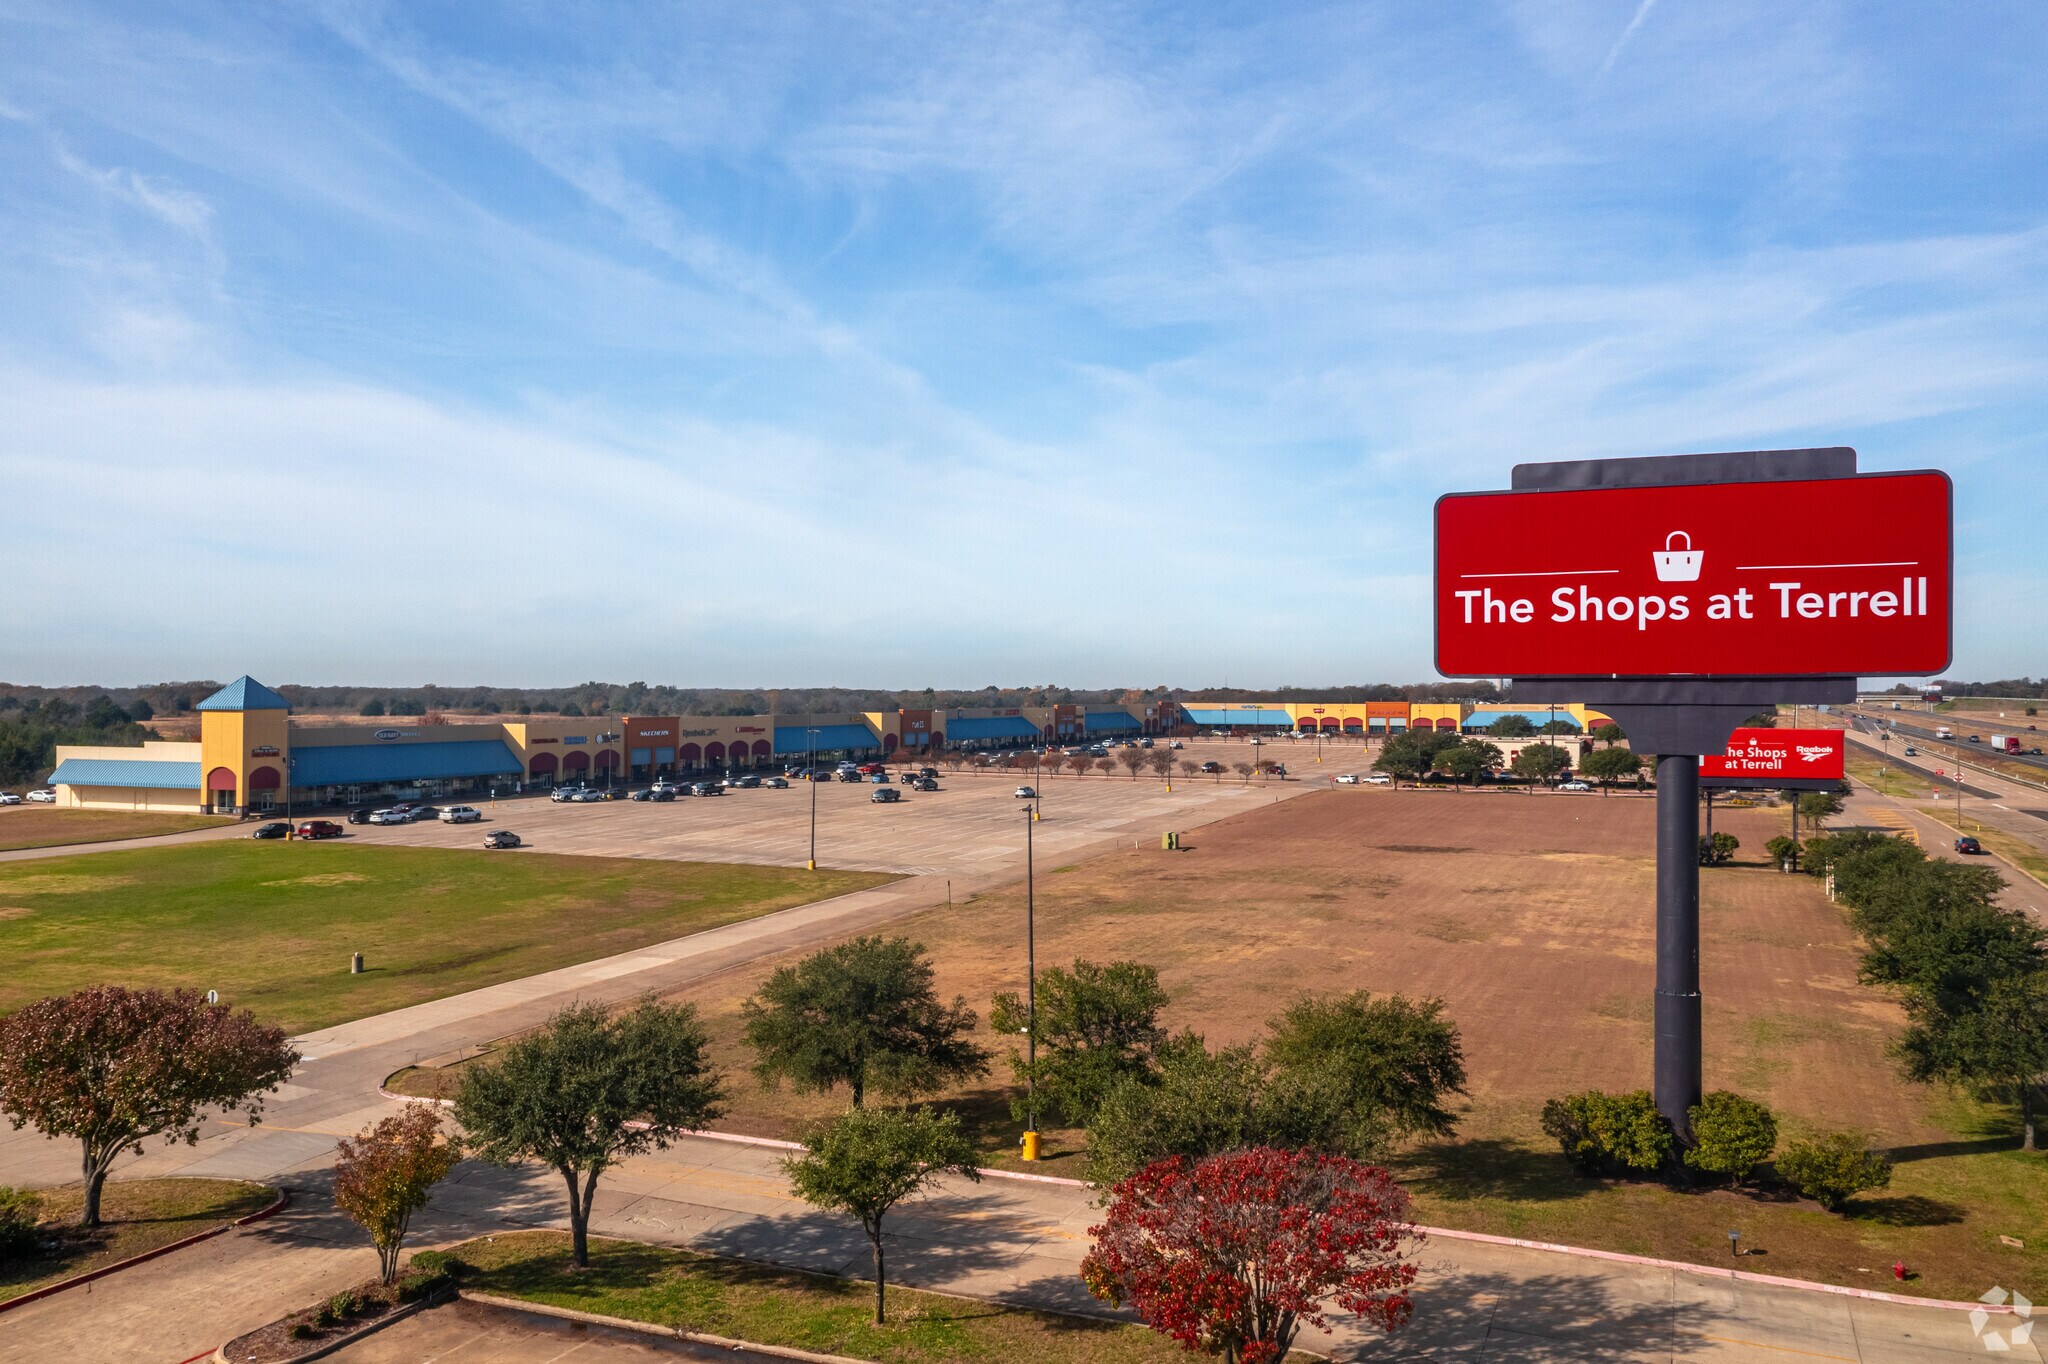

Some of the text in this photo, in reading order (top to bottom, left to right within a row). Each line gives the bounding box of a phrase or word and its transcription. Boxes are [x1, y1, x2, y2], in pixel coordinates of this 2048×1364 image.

[1454, 576, 1928, 631] The Shops at Terrell
[1725, 747, 1787, 760] he Shops
[1796, 745, 1833, 754] Reebok
[1725, 759, 1782, 770] at Terrell
